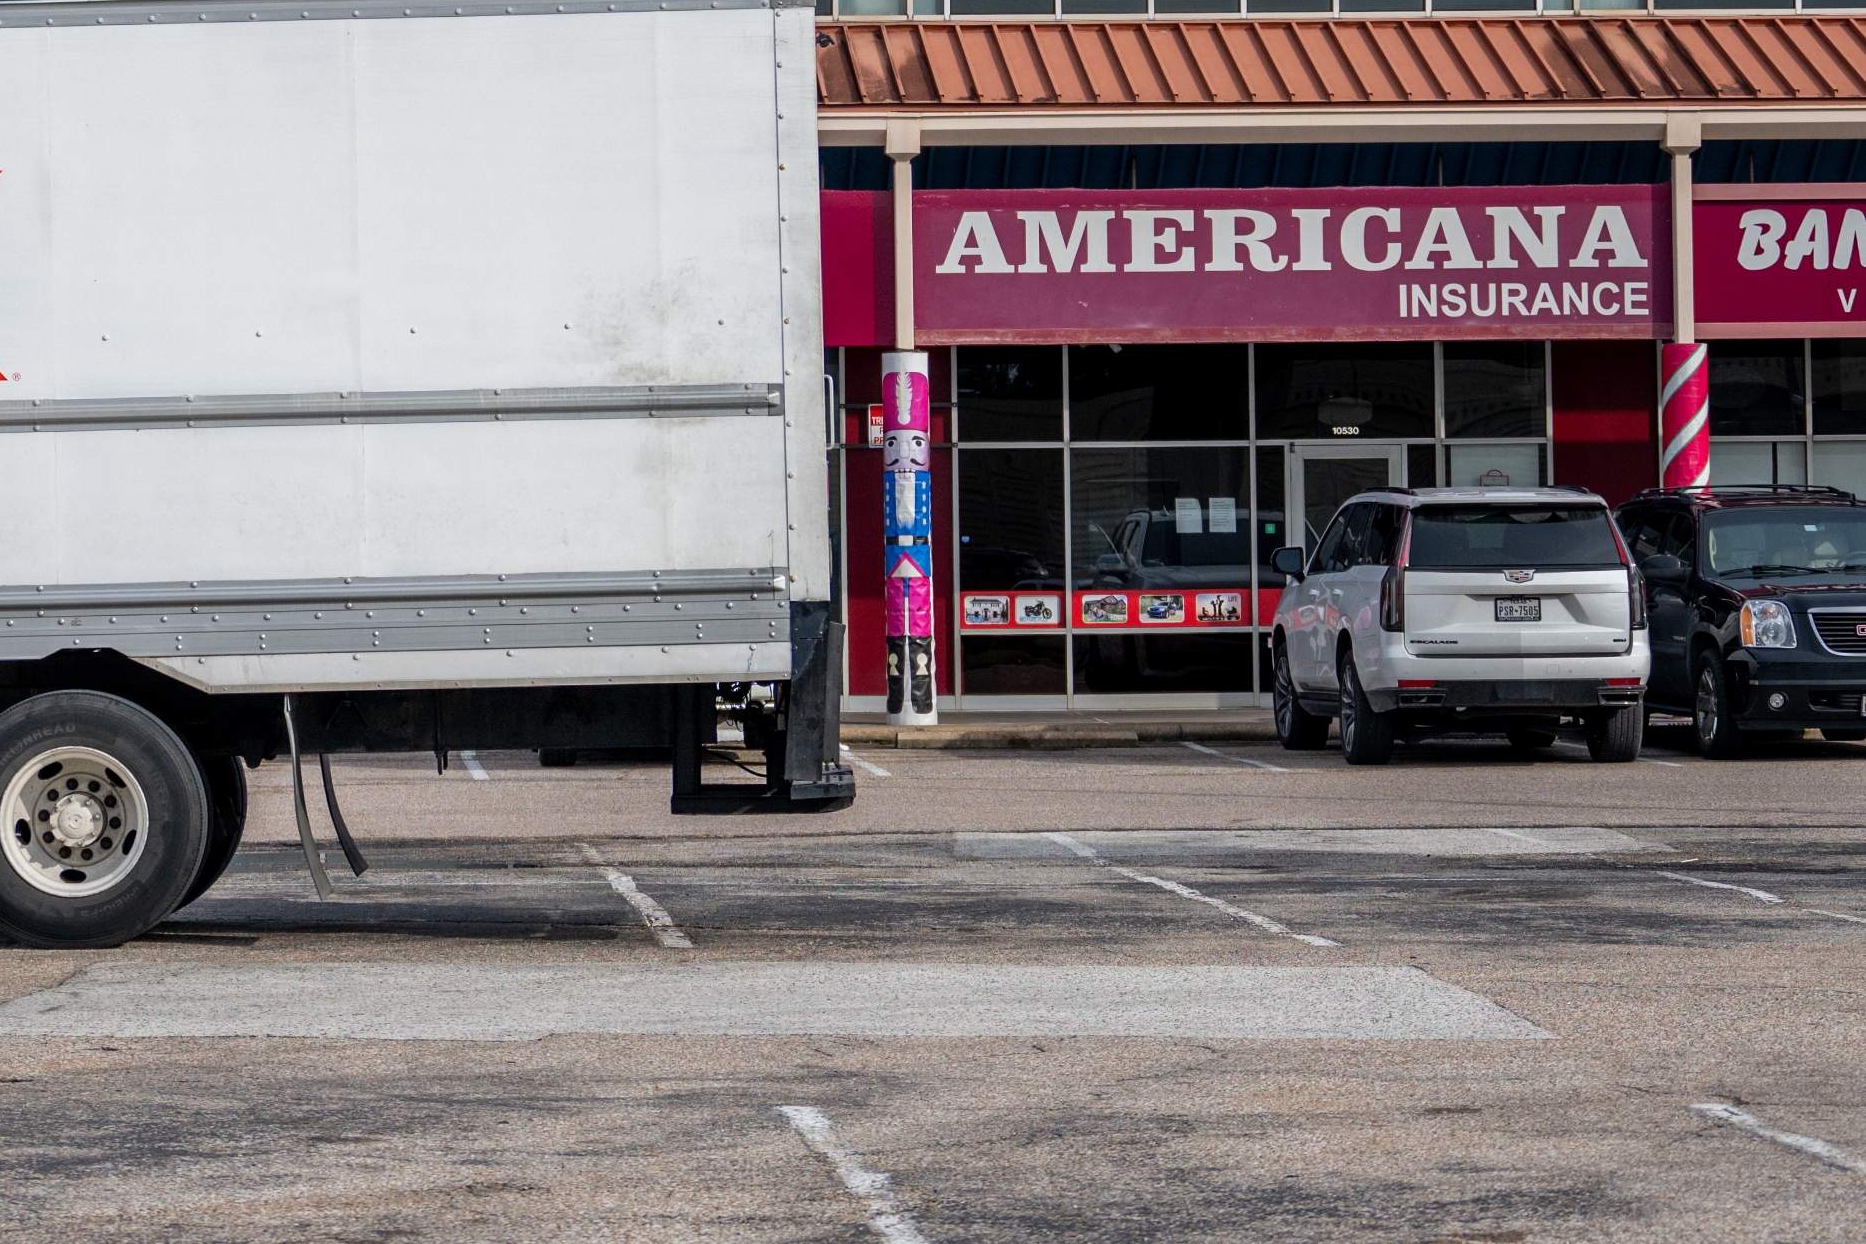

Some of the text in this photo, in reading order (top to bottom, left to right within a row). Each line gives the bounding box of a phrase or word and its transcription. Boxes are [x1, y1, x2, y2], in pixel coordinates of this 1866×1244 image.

[935, 205, 1648, 274] AMERICANA
[1398, 281, 1650, 318] INSURANCE
[1332, 425, 1360, 436] 10530
